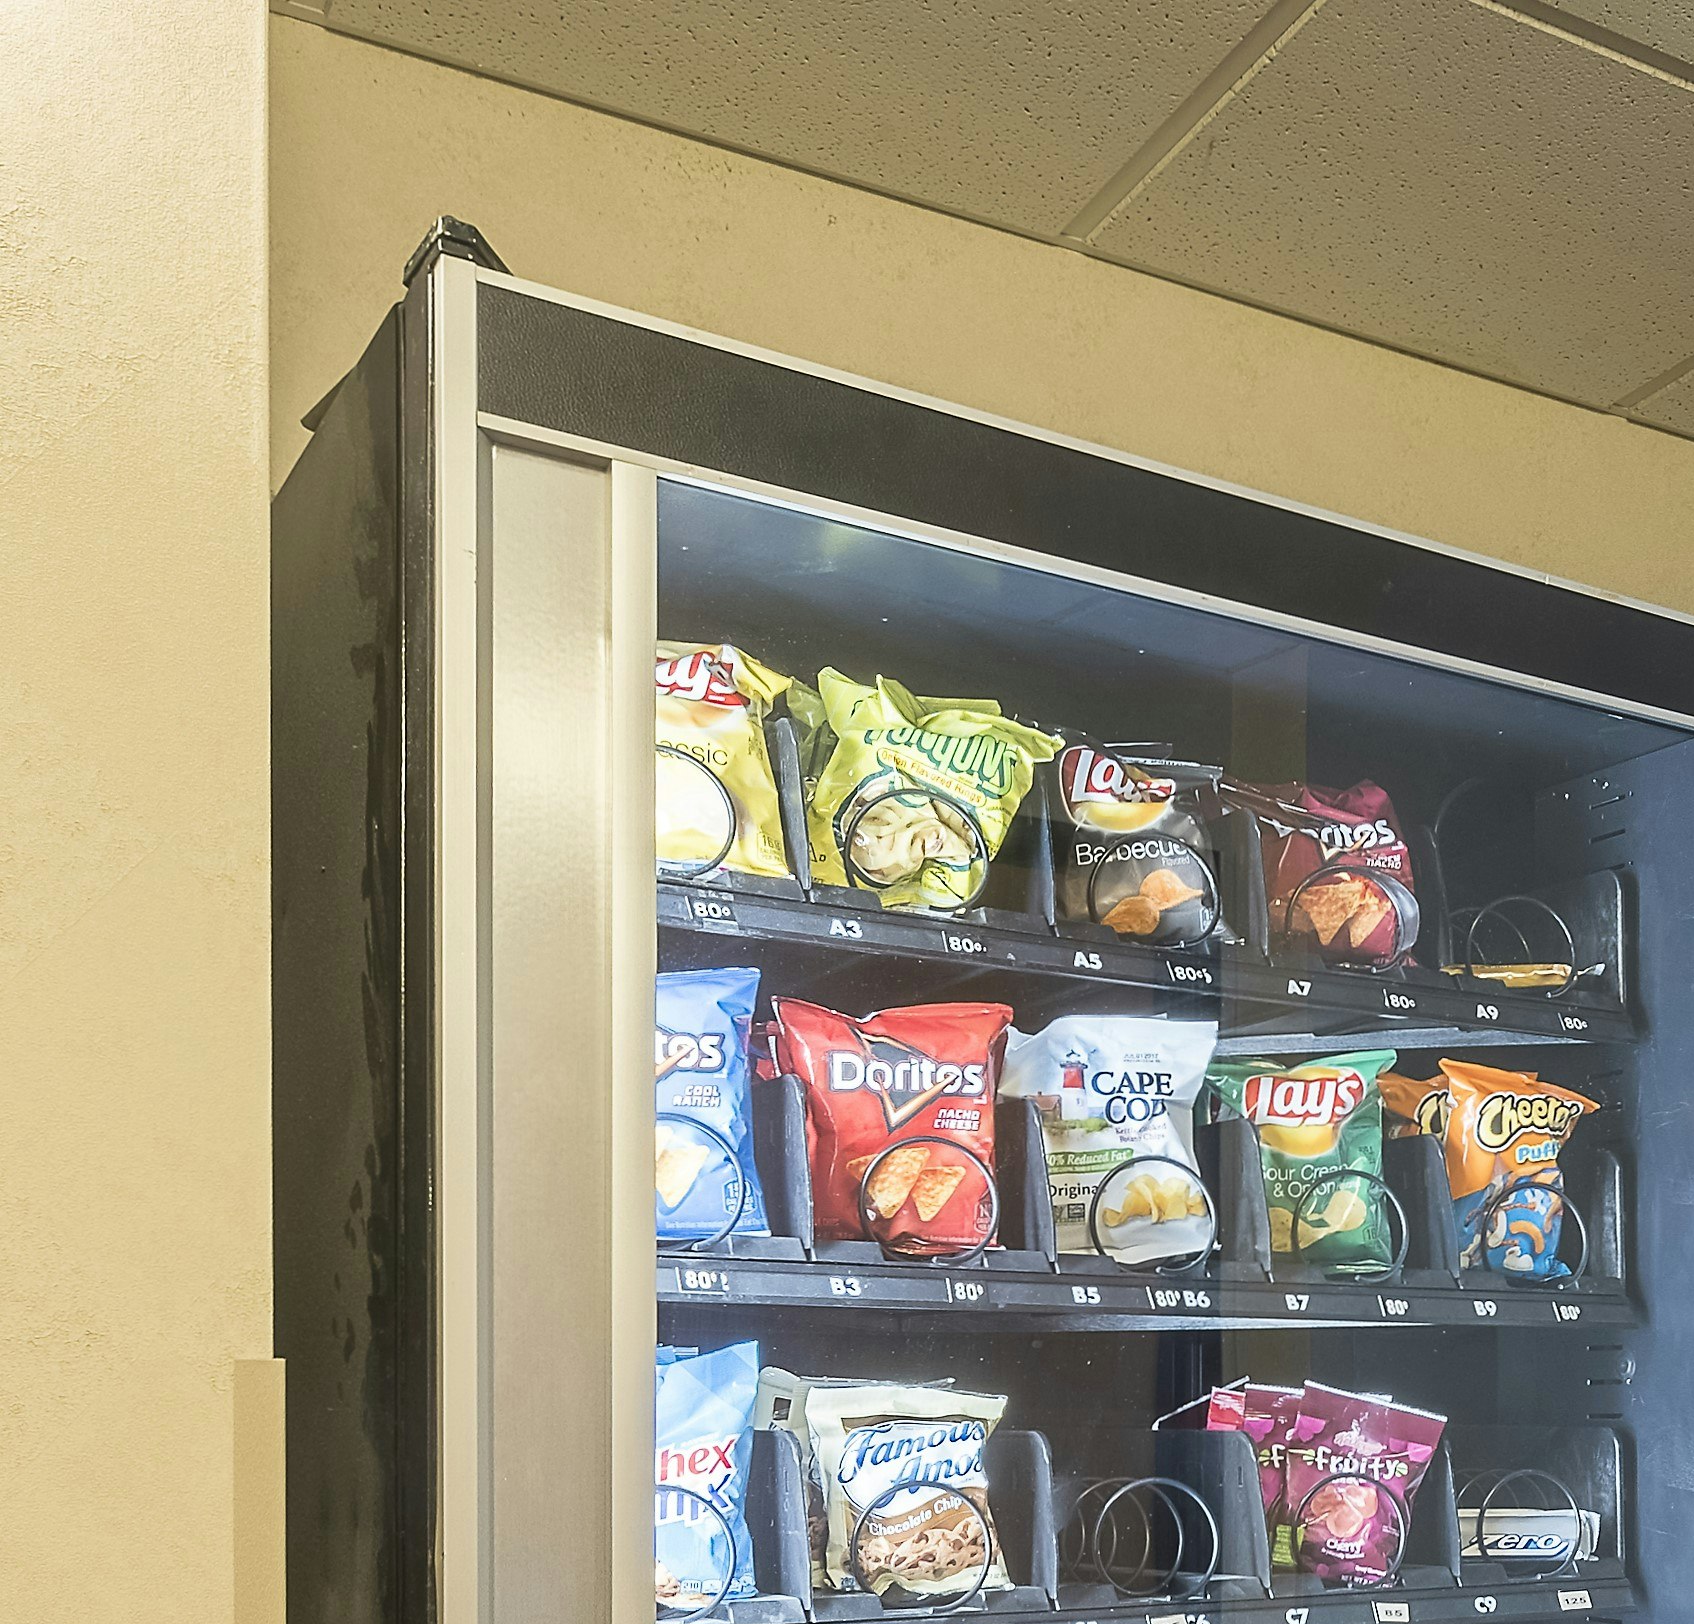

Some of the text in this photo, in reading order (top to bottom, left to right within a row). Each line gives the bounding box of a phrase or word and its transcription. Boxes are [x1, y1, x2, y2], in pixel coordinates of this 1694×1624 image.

[829, 919, 864, 939] A3
[1073, 951, 1103, 970] A5
[1287, 979, 1312, 997] A7
[1476, 1004, 1499, 1022] A9
[830, 1051, 986, 1095] Doritos
[684, 1084, 720, 1099] COOL
[1091, 1071, 1175, 1097] CAPE
[672, 1094, 721, 1109] RANCH
[937, 1108, 981, 1121] NACHO
[933, 1117, 981, 1131] CHEESE
[1066, 1153, 1109, 1166] Reduced
[1273, 1182, 1285, 1198] &
[829, 1276, 863, 1297] B3
[1071, 1286, 1101, 1305] B5
[1184, 1291, 1212, 1309] B6
[1285, 1294, 1310, 1311] B7
[1473, 1300, 1497, 1317] B9
[837, 1421, 986, 1484] Famous
[870, 1450, 983, 1508] Amos
[869, 1495, 964, 1537] Chocolate Chip
[1563, 1596, 1587, 1605] 125
